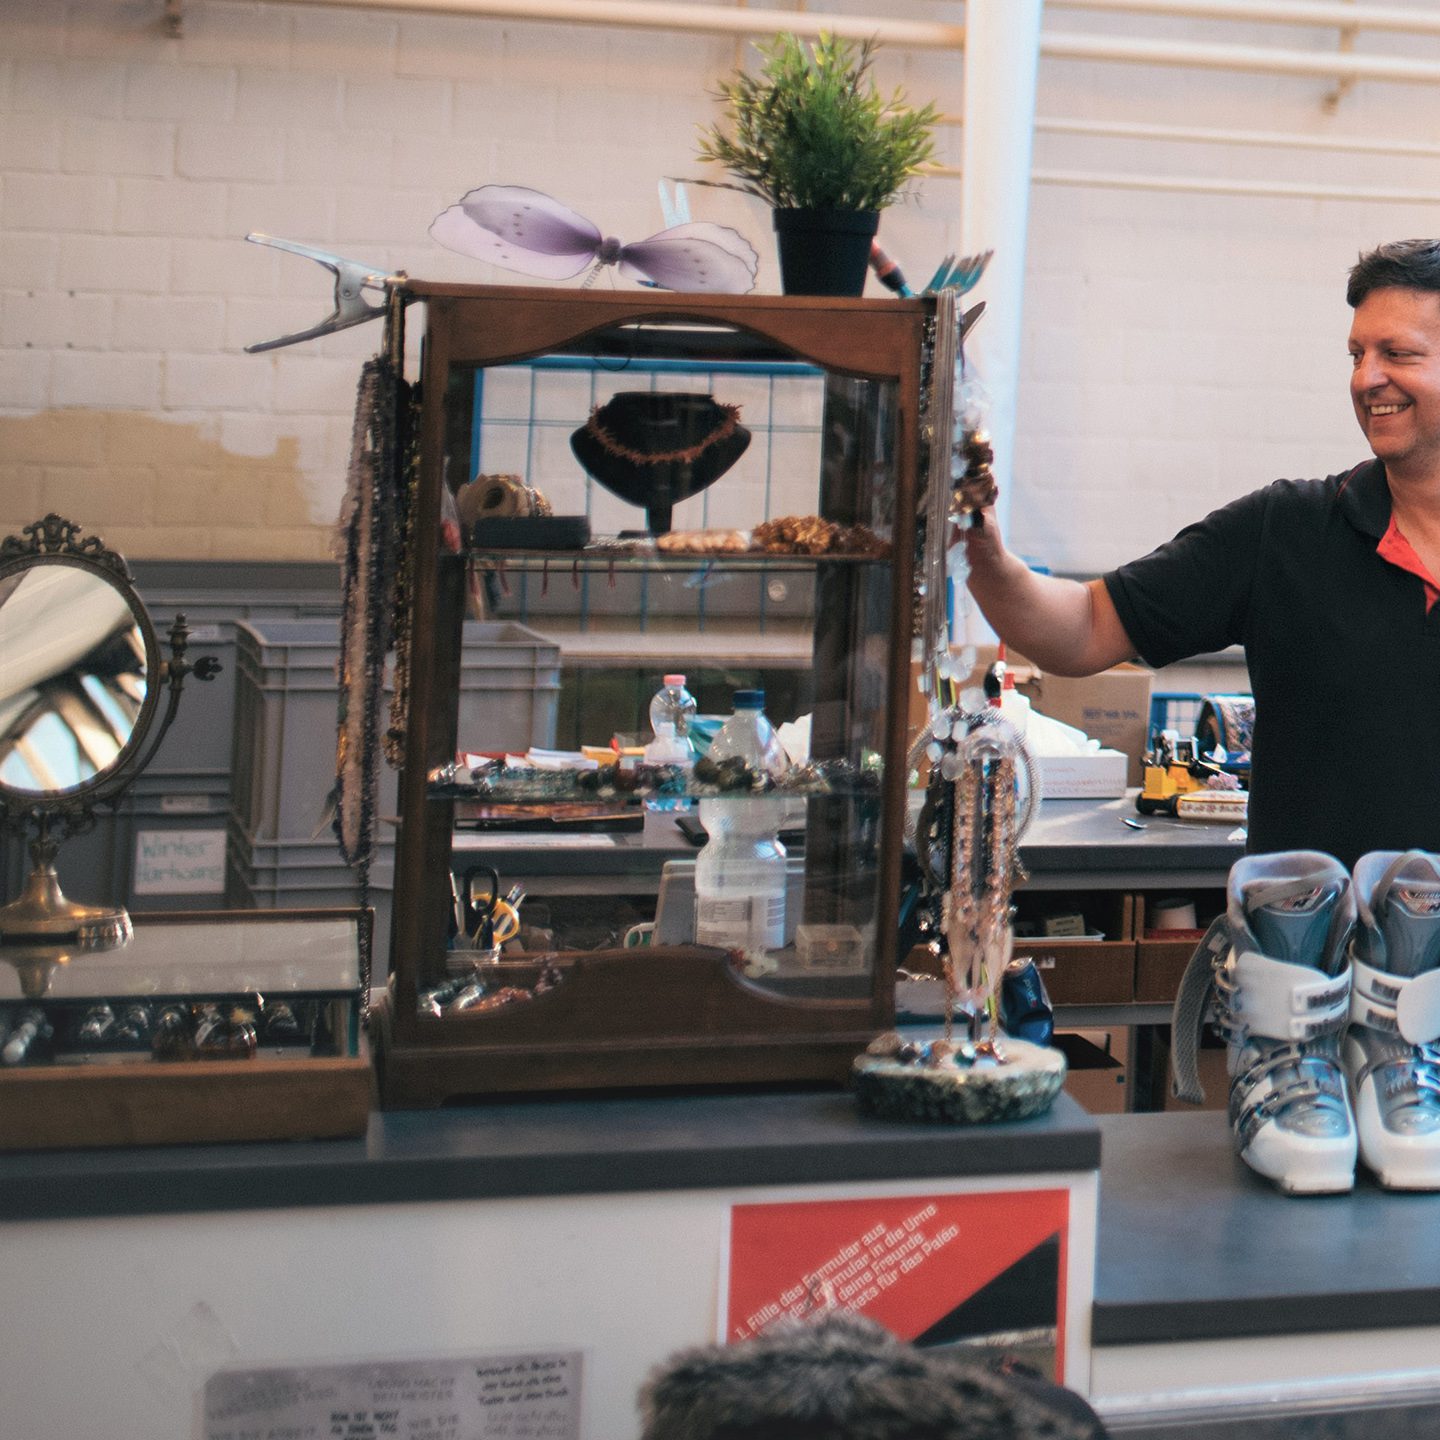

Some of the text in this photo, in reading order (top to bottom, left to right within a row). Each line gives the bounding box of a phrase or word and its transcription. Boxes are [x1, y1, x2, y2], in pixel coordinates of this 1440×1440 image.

[869, 1243, 884, 1259] in
[884, 1228, 905, 1248] die
[902, 1204, 937, 1232] Urne
[877, 1269, 898, 1290] für
[899, 1252, 924, 1274] das
[921, 1225, 959, 1256] Paléo
[746, 1303, 780, 1332] Fülle
[780, 1285, 805, 1307] das
[802, 1240, 861, 1289] Formular
[861, 1223, 886, 1246] aus
[838, 1231, 924, 1301] deine Freunde
